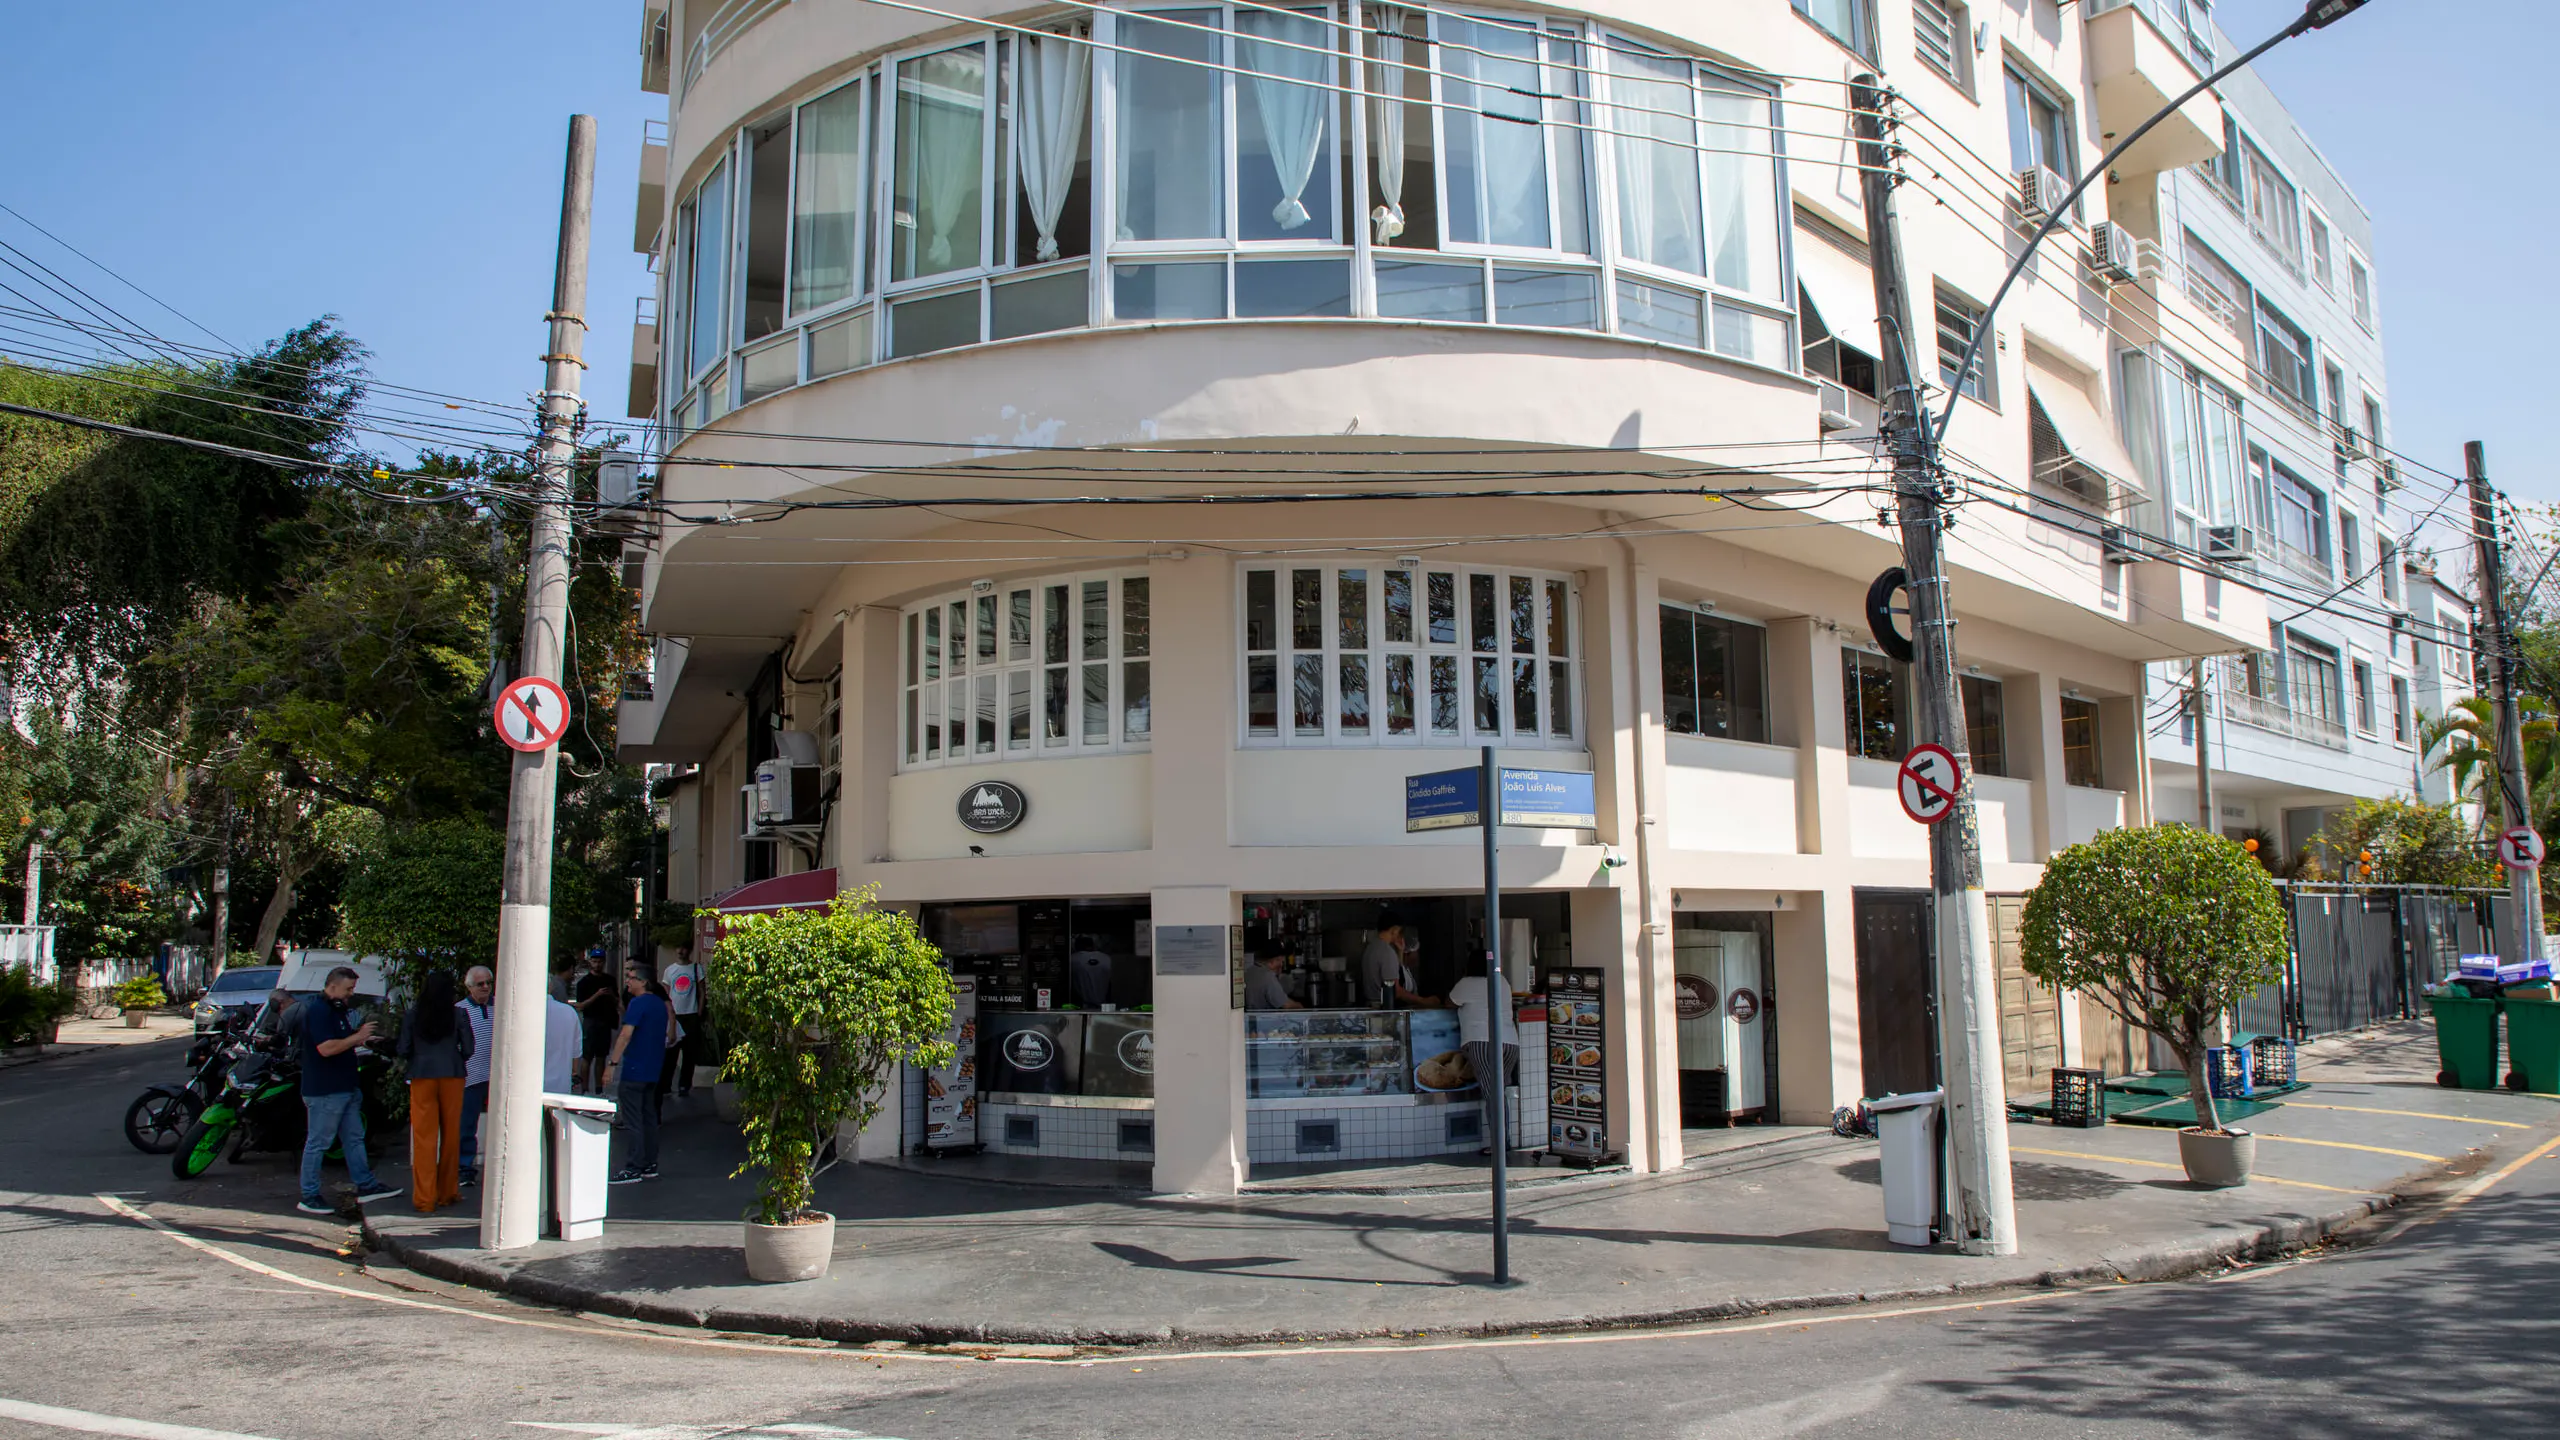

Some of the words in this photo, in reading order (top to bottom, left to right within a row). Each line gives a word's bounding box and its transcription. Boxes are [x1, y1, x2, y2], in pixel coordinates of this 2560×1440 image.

[1503, 770, 1538, 780] Avenida
[1408, 779, 1419, 788] Rua
[1503, 781, 1525, 792] João
[1545, 783, 1566, 793] Alves
[1432, 783, 1456, 796] Gaffrée
[1463, 813, 1478, 824] 205
[1505, 812, 1522, 824] 380
